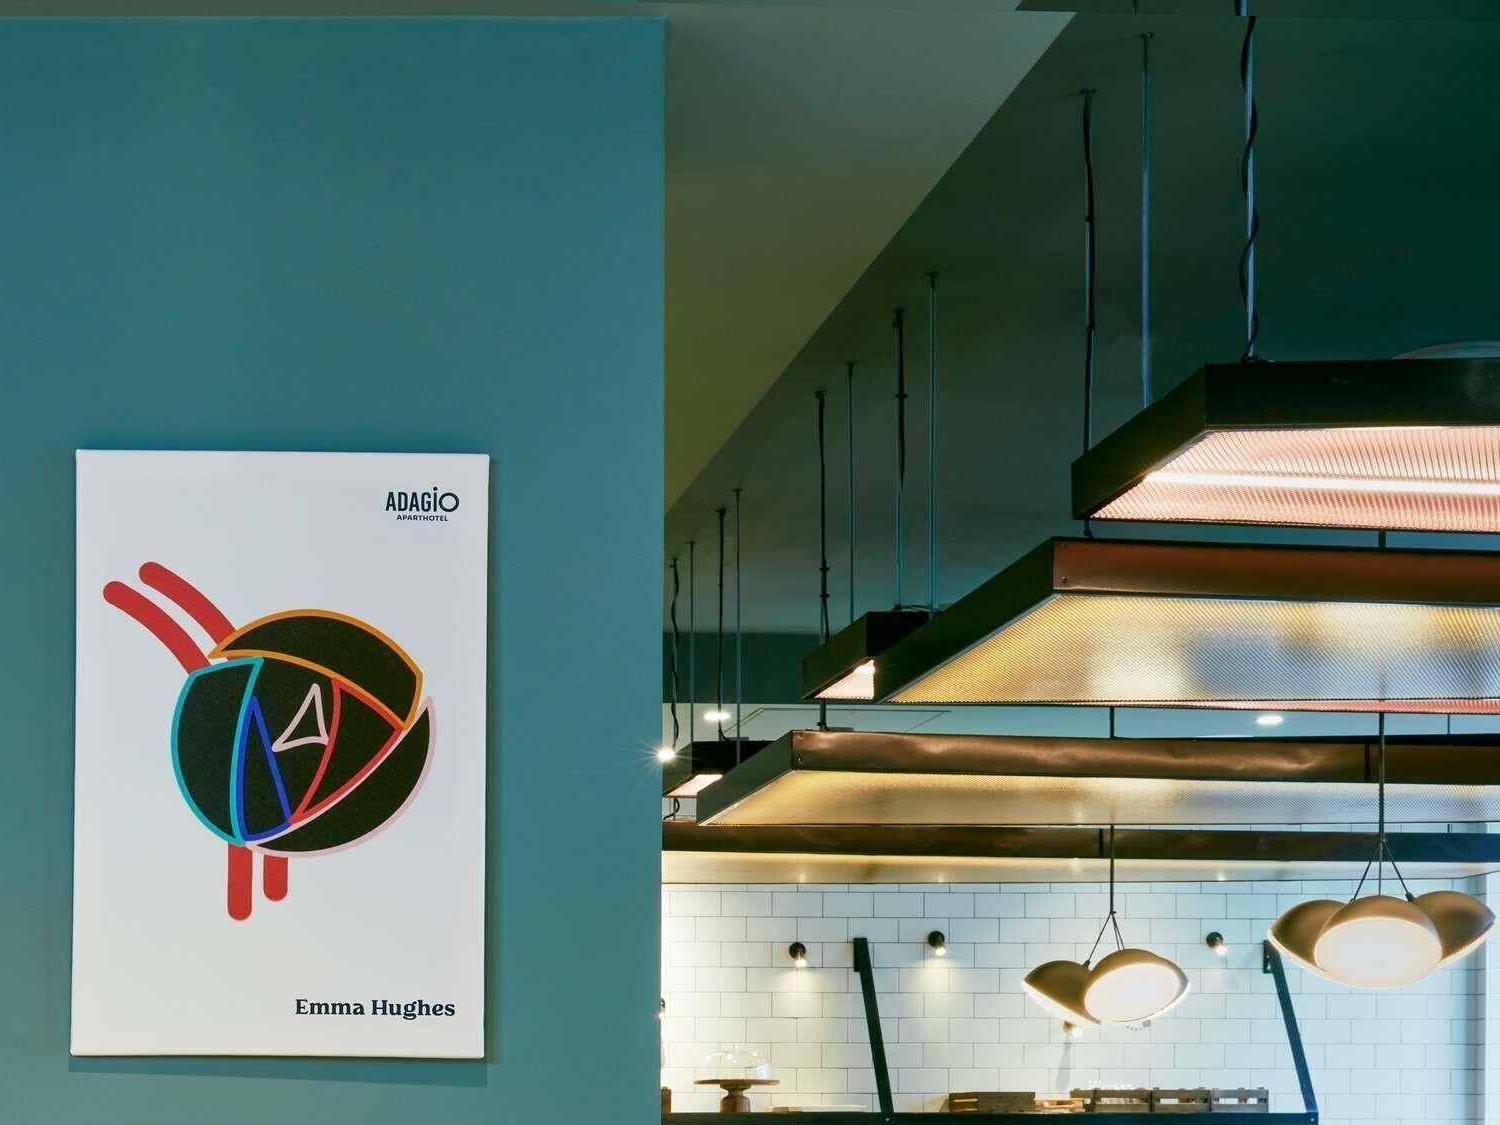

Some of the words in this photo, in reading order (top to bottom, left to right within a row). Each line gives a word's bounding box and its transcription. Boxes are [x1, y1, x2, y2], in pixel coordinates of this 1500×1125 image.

[396, 513, 449, 522] APARTHOTEL
[294, 998, 366, 1016] Emma
[371, 998, 456, 1021] Hughes
